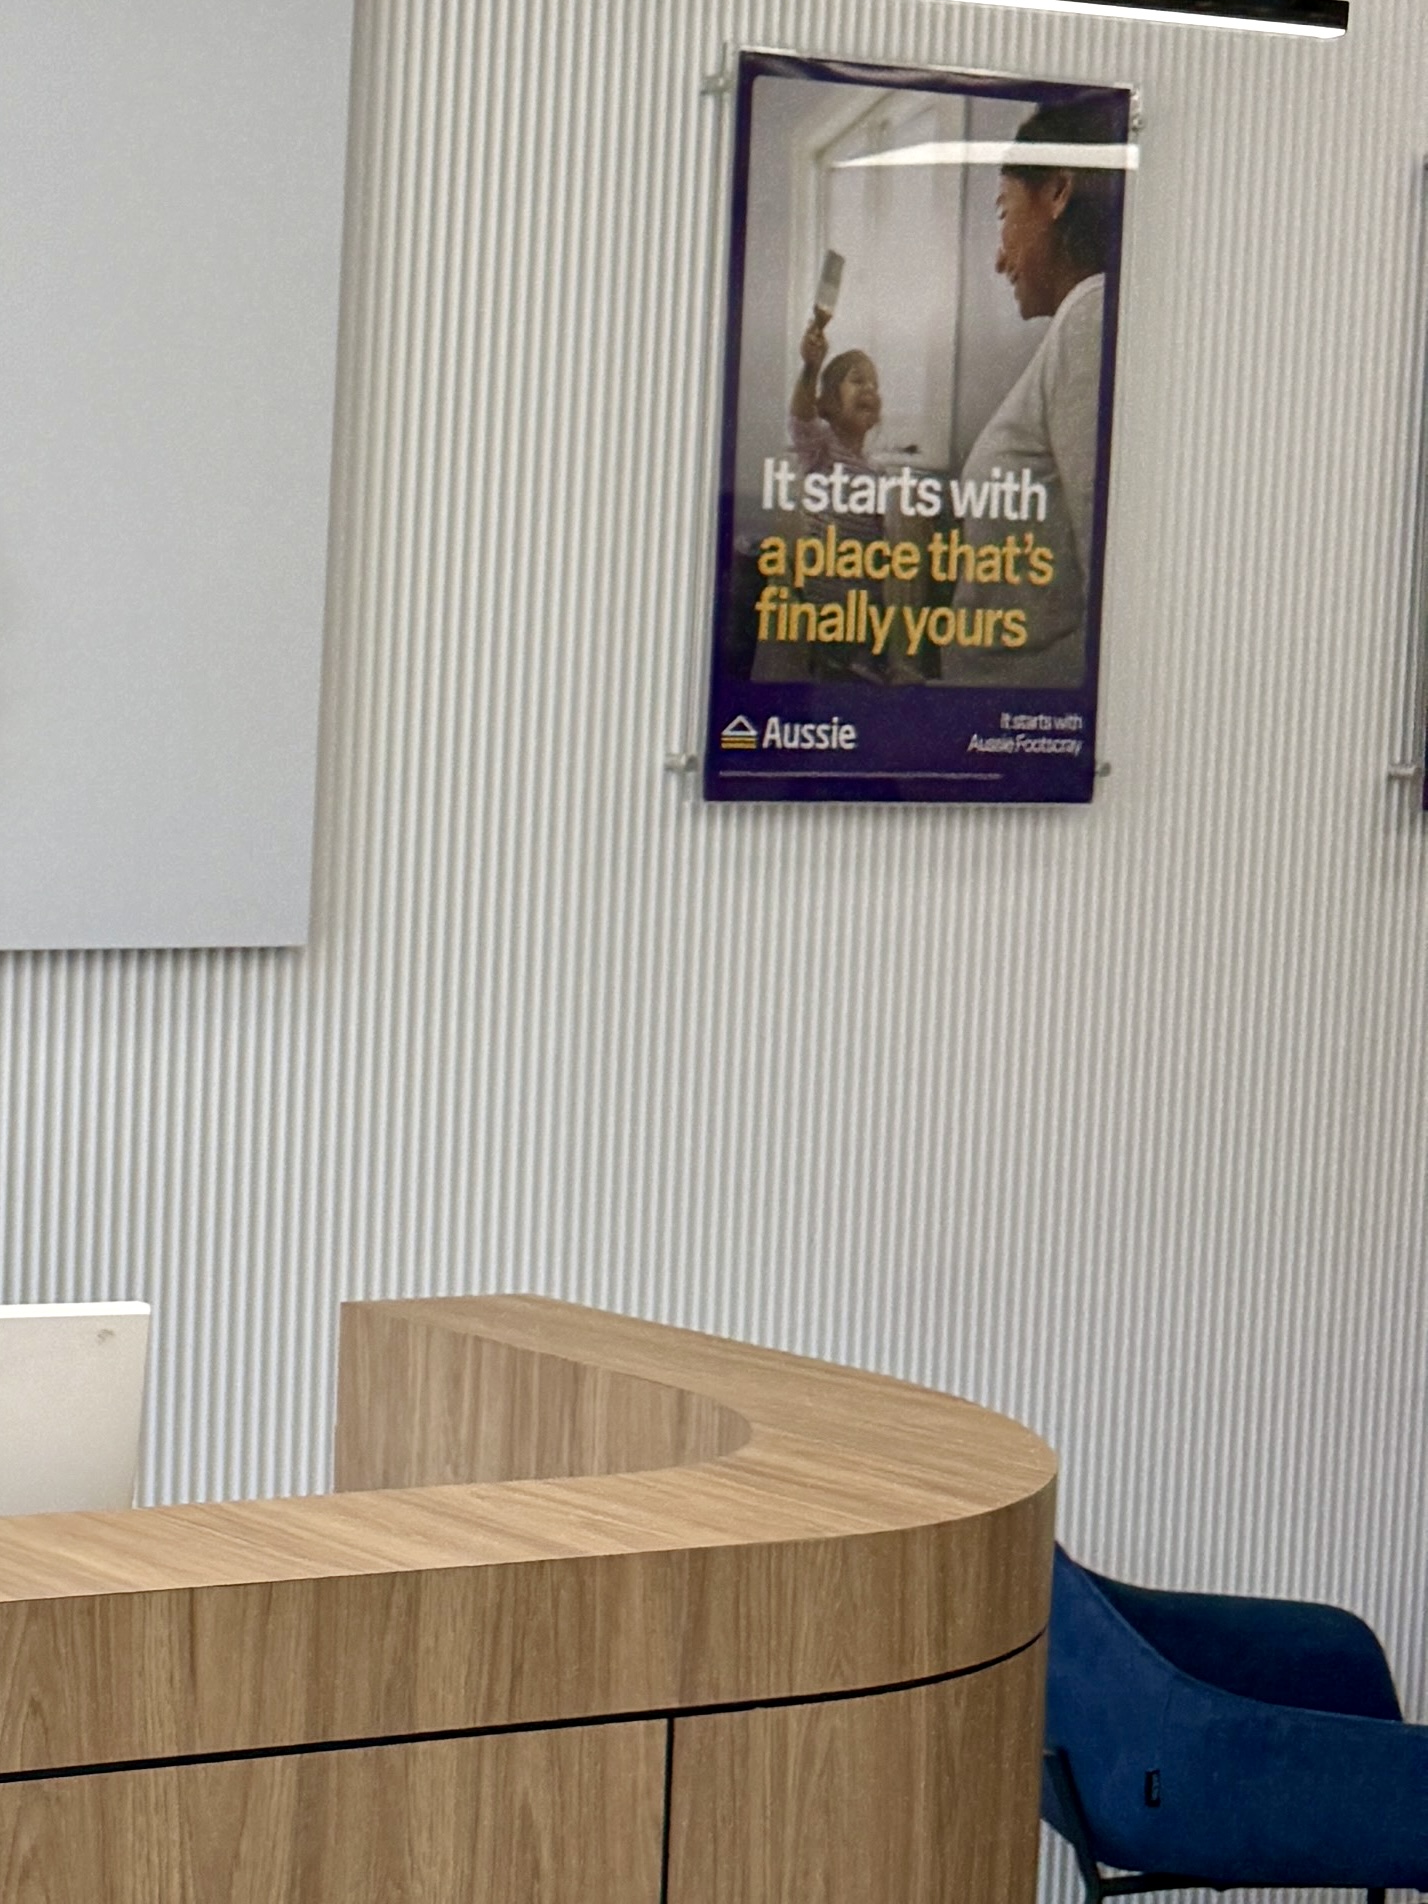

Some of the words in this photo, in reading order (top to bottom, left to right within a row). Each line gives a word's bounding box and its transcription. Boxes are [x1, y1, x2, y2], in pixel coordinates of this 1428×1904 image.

[761, 457, 796, 512] It
[802, 462, 942, 517] starts
[949, 467, 1047, 522] with
[757, 536, 786, 577] a
[793, 524, 922, 588] place
[927, 528, 1054, 586] that's
[755, 585, 895, 656] finally
[902, 605, 1028, 656] yours
[761, 716, 857, 750] Aussie
